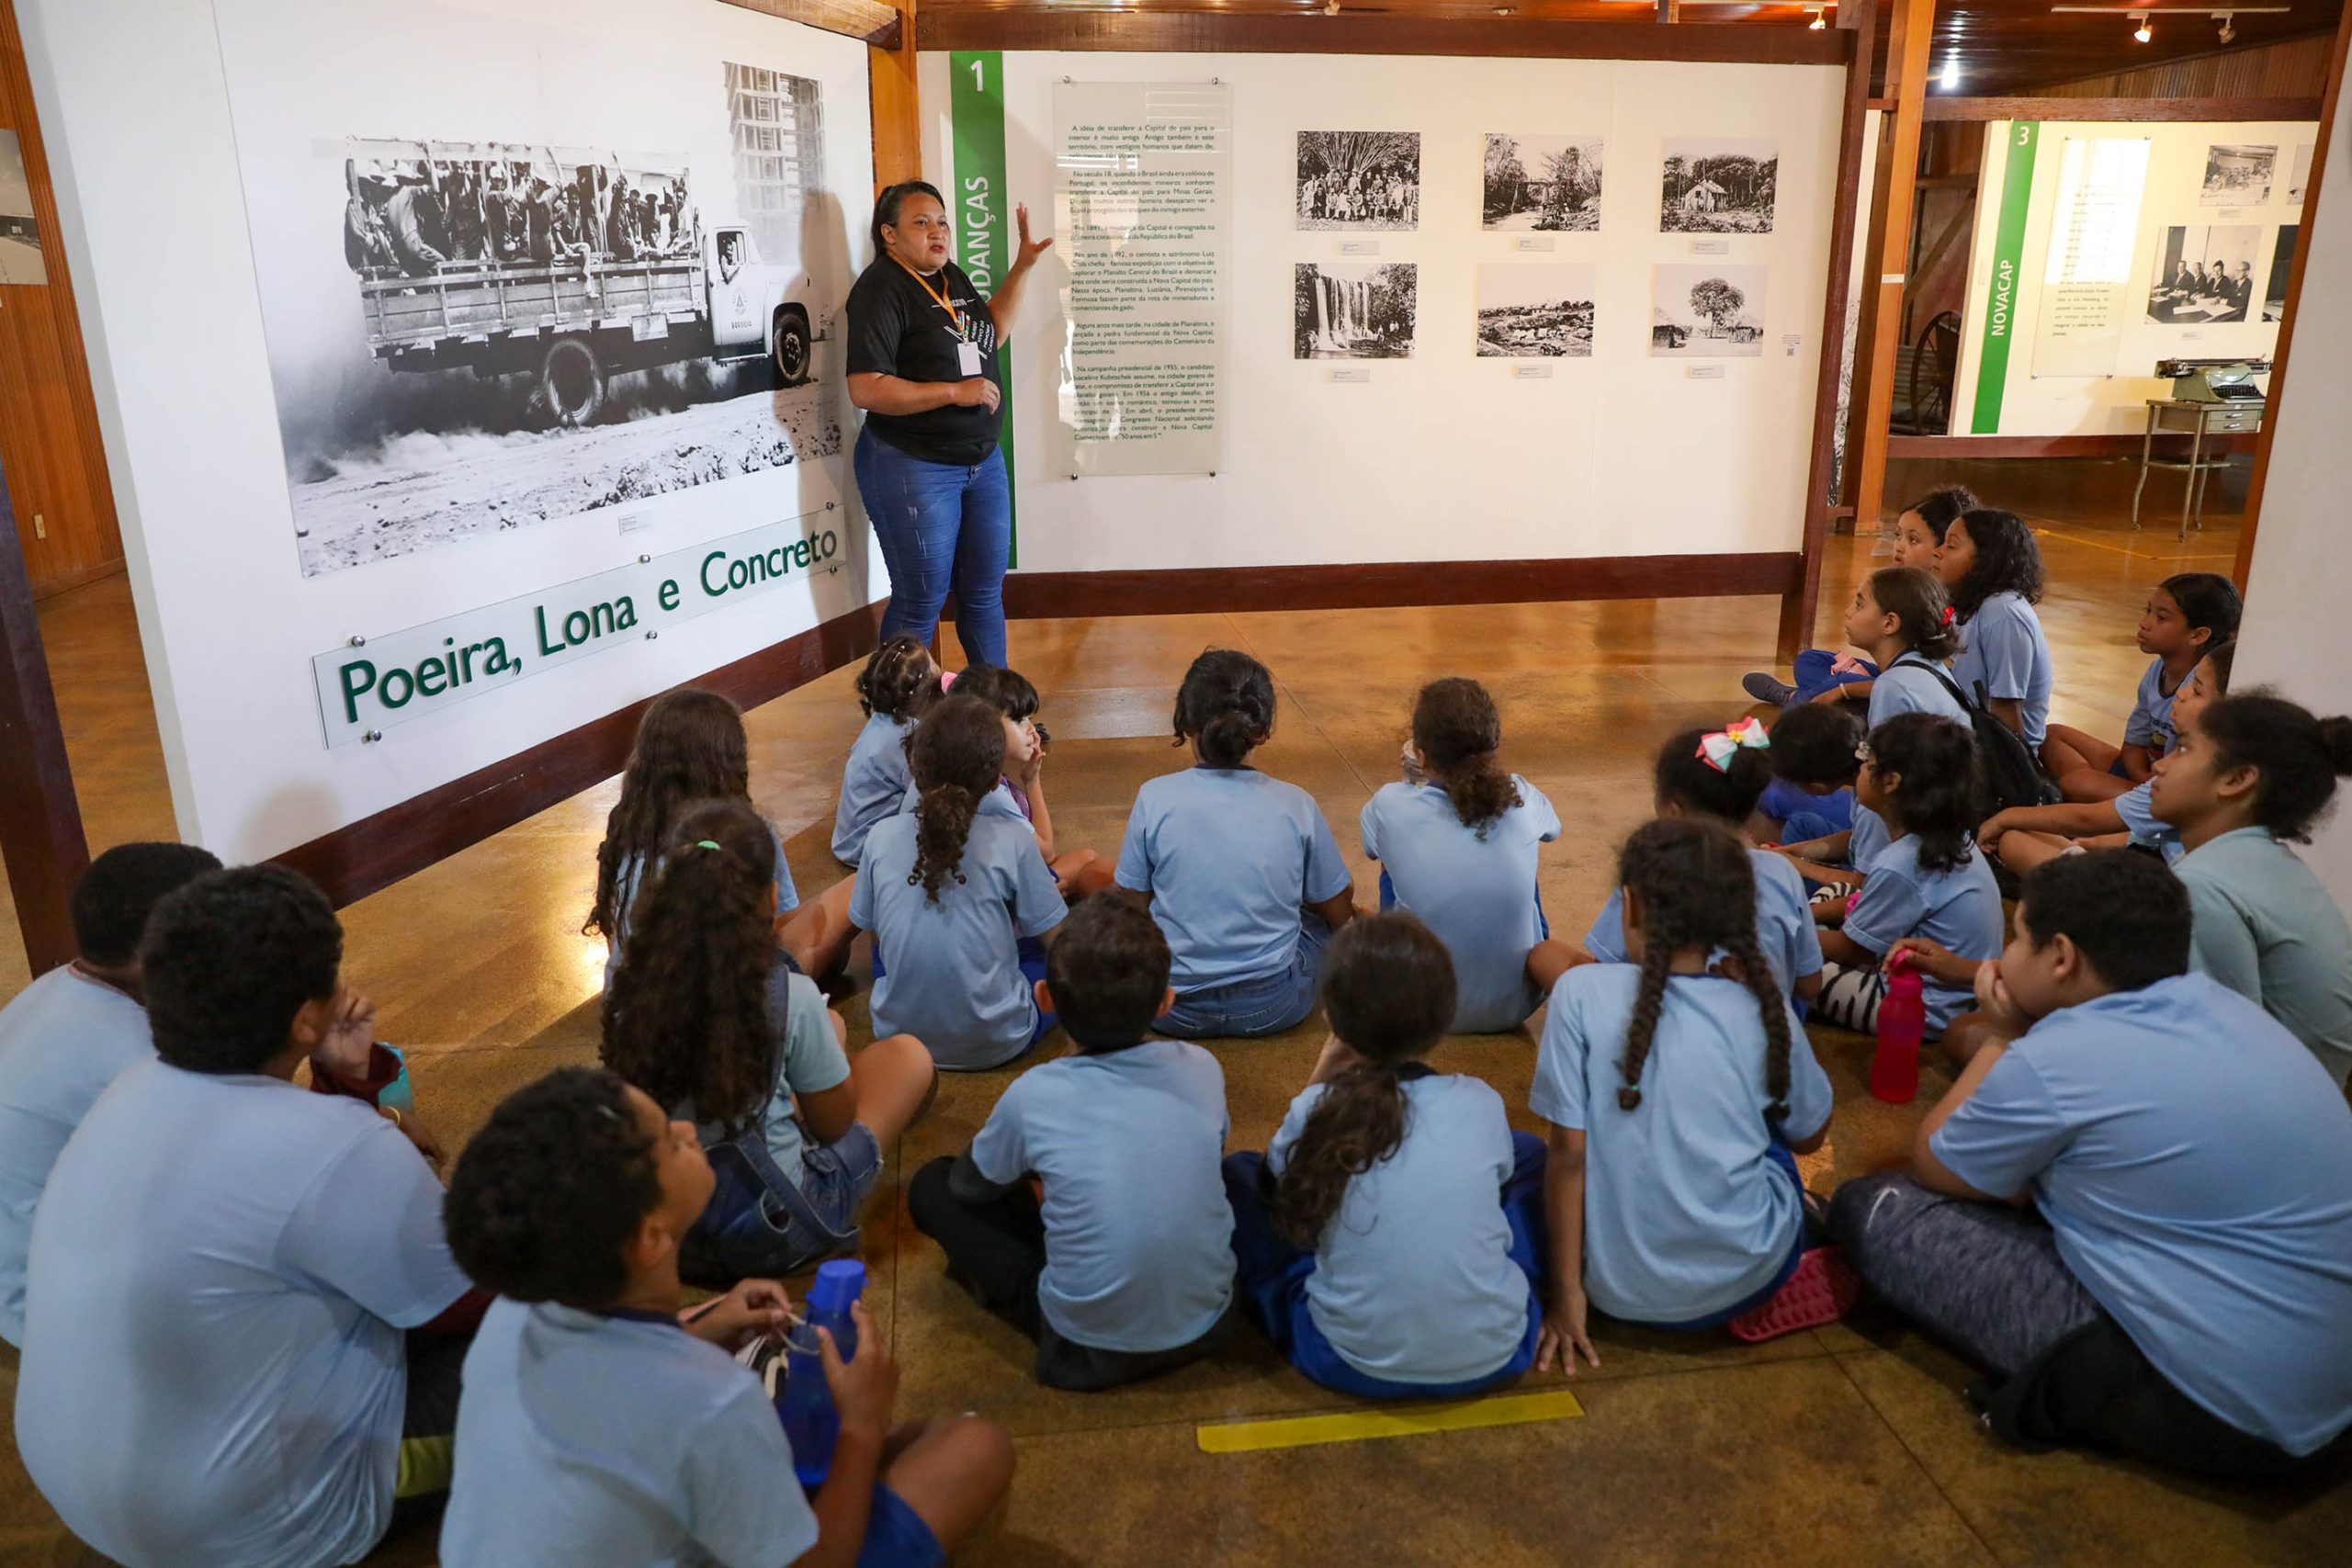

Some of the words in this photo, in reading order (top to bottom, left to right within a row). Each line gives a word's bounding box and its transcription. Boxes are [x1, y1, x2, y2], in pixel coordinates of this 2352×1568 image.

[969, 59, 984, 92] 1
[2018, 126, 2030, 146] 3
[966, 175, 996, 303] DANÇAS
[1991, 259, 2013, 336] NOVACAP
[339, 637, 522, 724] Poeira,
[534, 595, 639, 658] Lona
[657, 578, 680, 612] e
[700, 529, 838, 597] Concreto
